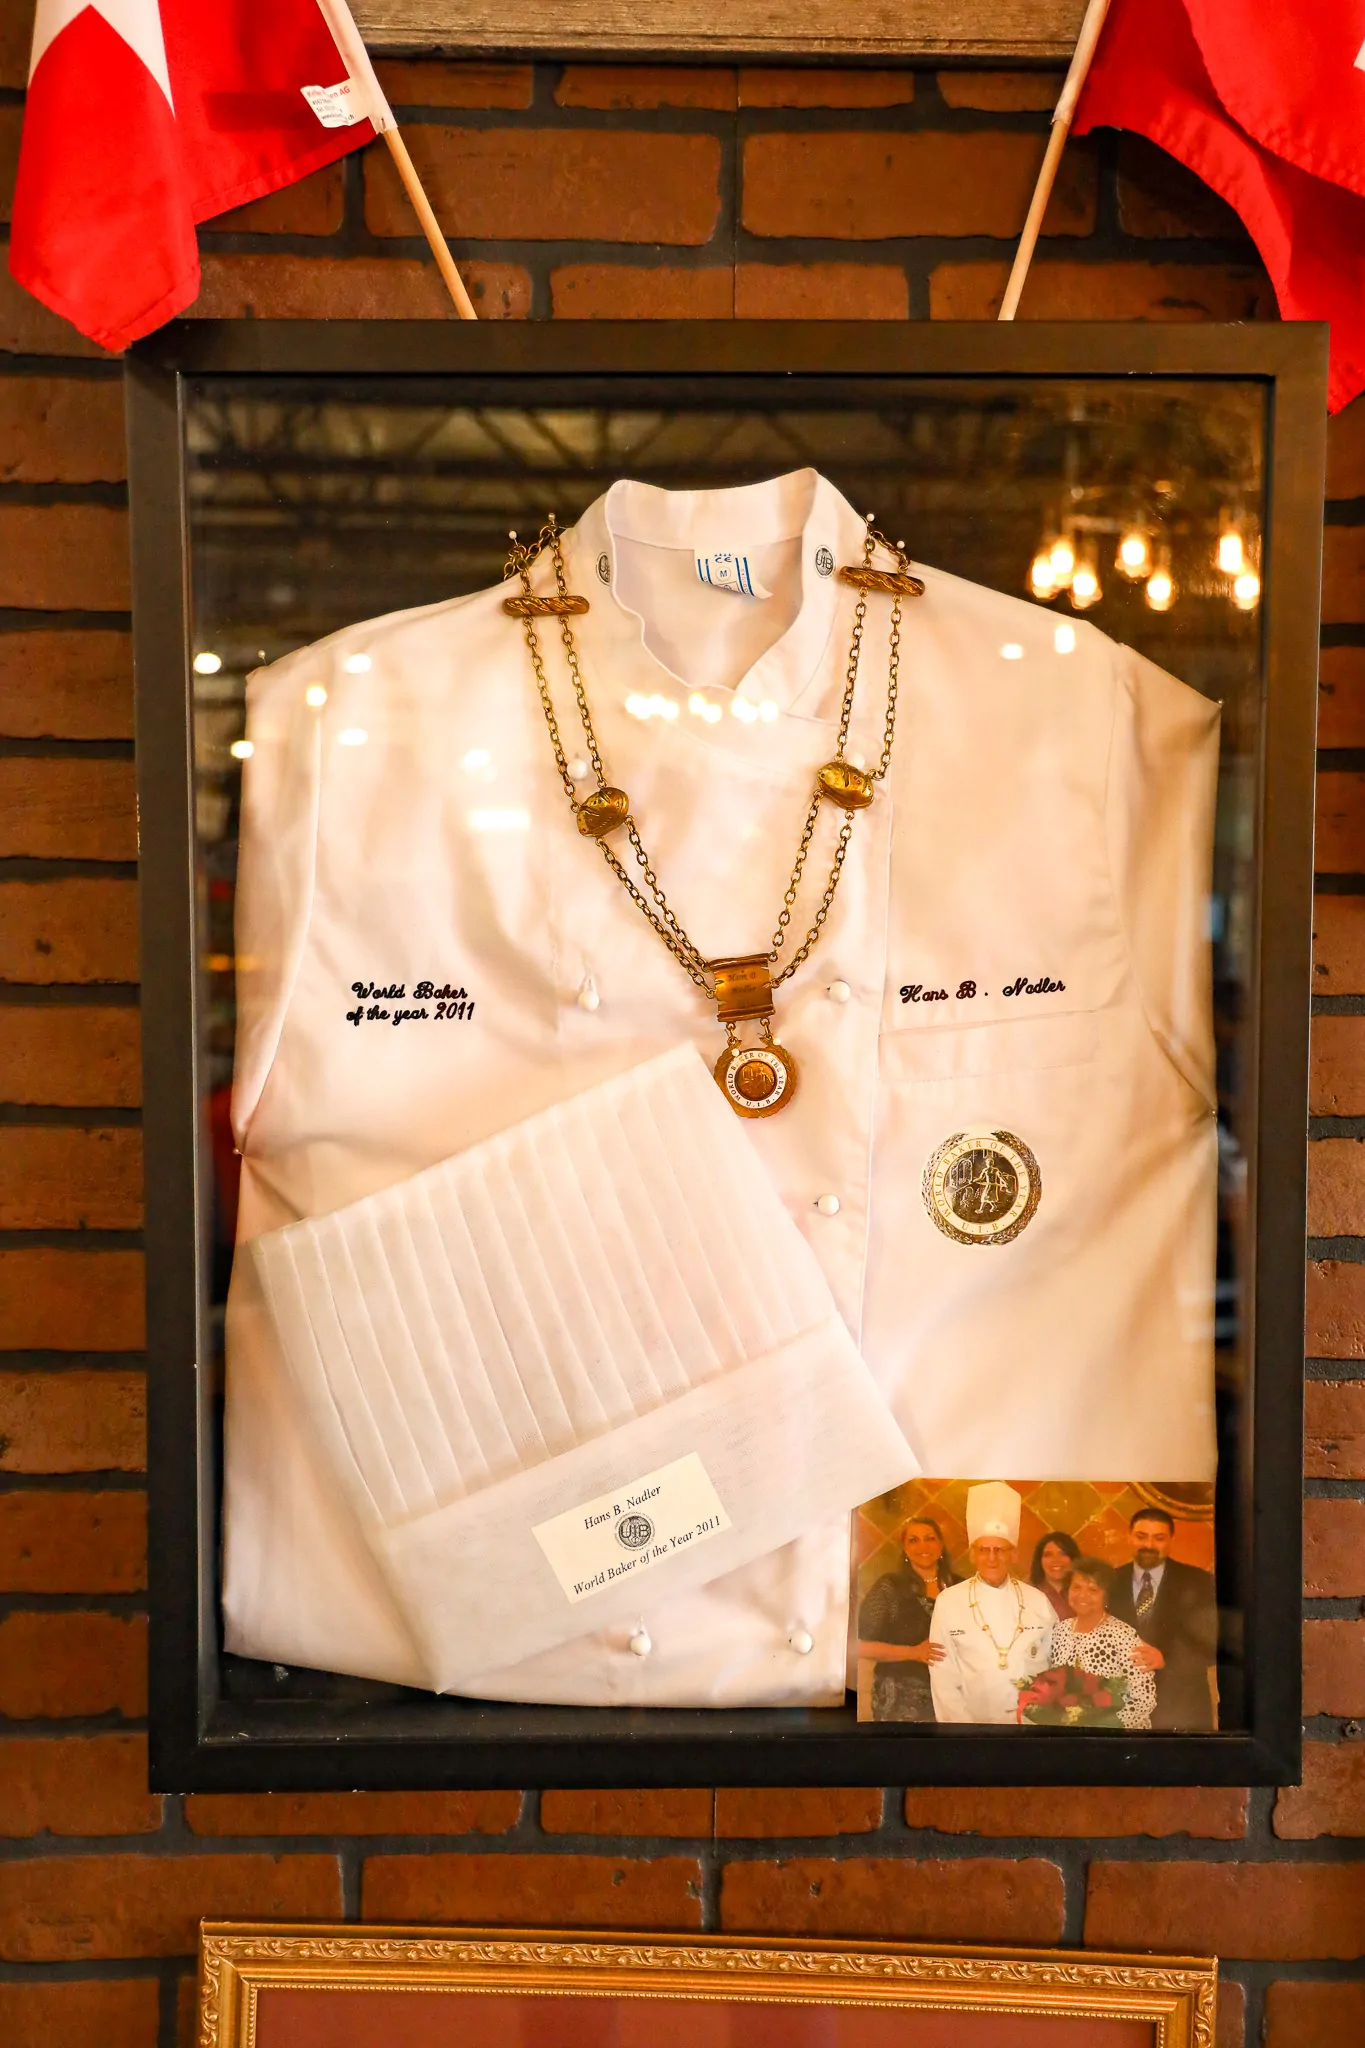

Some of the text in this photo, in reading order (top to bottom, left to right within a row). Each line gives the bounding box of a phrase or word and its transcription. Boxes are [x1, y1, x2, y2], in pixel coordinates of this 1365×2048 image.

[340, 85, 351, 96] AG
[719, 569, 728, 578] M
[351, 981, 468, 999] World Baker
[899, 984, 949, 1003] Hans
[1002, 977, 1066, 997] Nadler
[346, 1001, 475, 1026] of the year 2011
[727, 1073, 741, 1101] WORLD
[774, 1074, 785, 1096] YEAR
[935, 1140, 1028, 1218] WORLD BAKER OF THE YEAR
[584, 1486, 661, 1530] Hans B. Nadler
[620, 1524, 650, 1539] UIB
[573, 1515, 721, 1595] World Baker of the Year 2011
